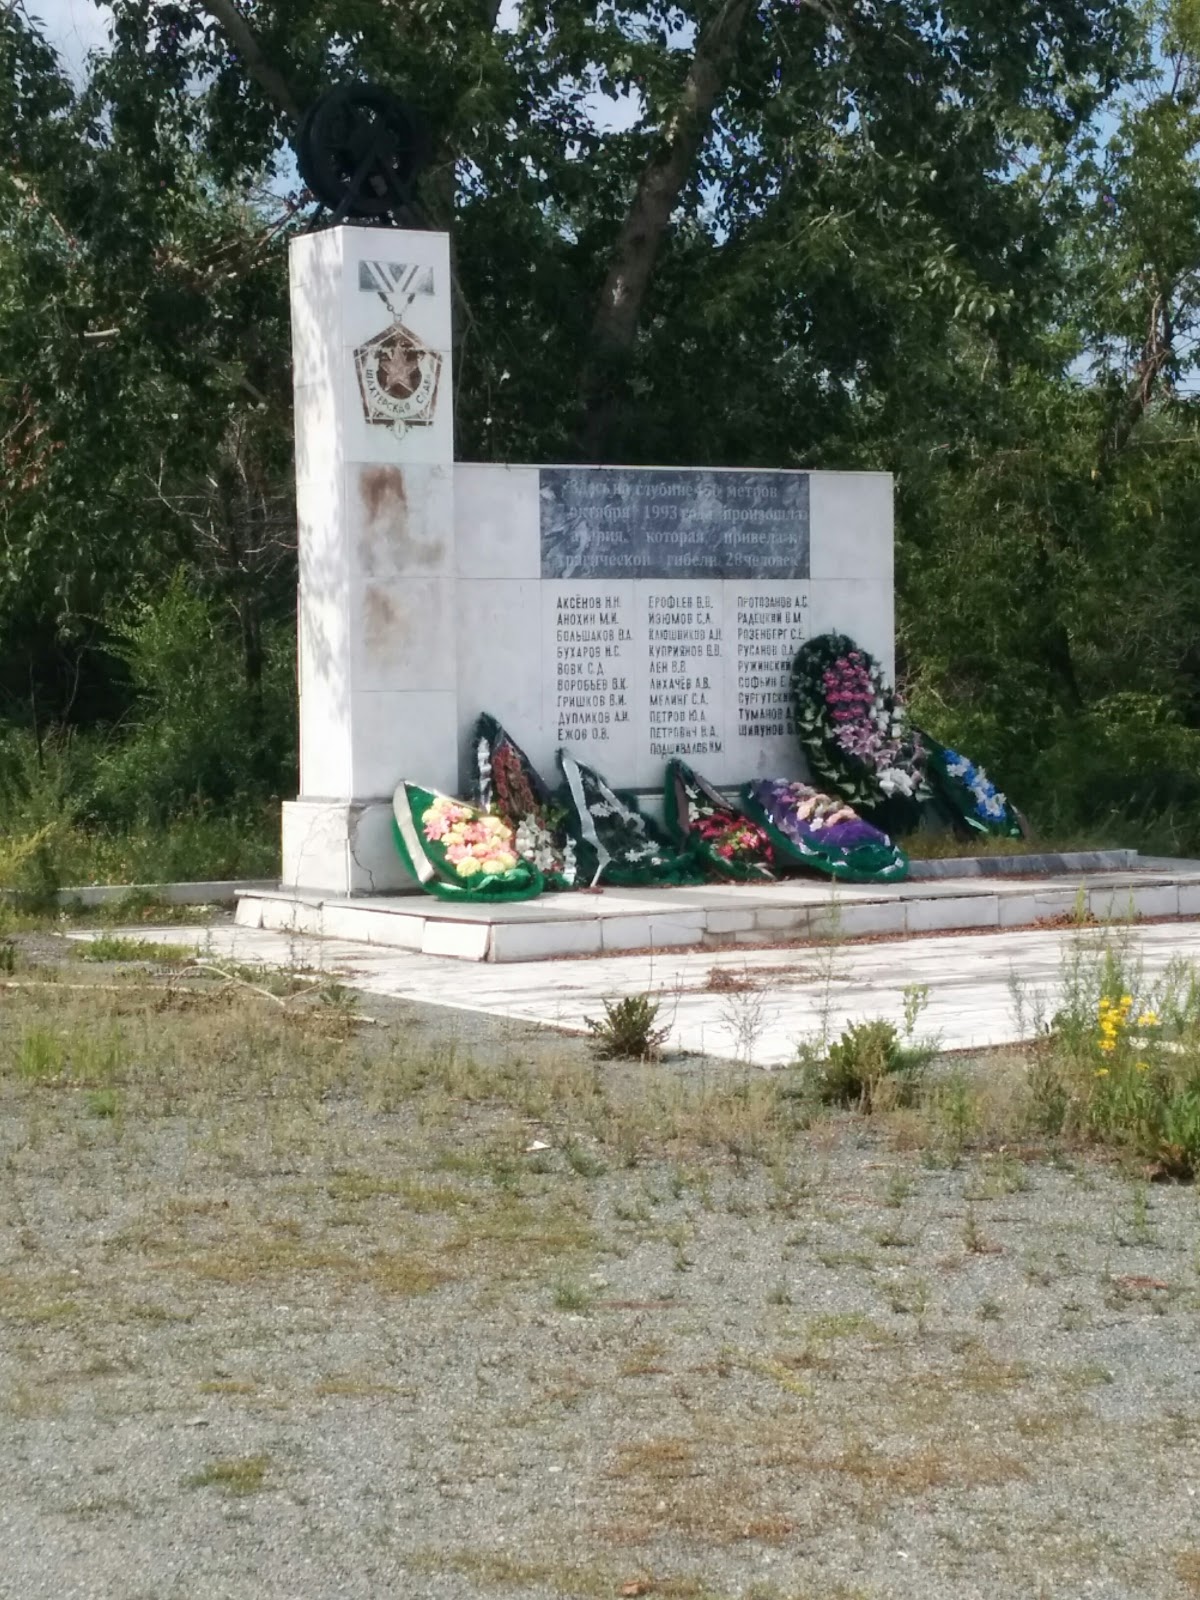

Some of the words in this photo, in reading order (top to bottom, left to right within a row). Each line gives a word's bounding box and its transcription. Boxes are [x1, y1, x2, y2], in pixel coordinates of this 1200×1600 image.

[635, 480, 693, 500] глубине
[727, 484, 778, 499] метров
[644, 504, 679, 520] 1993
[723, 508, 808, 524] произошла
[646, 530, 704, 547] которая
[724, 531, 784, 548] привела
[666, 551, 717, 568] гибели
[725, 551, 742, 567] 28
[743, 554, 799, 568] человек
[556, 594, 601, 609] АКСЁНОВ
[648, 595, 692, 609] ЕРОФЕЕВ
[557, 613, 595, 626] АНОХИН
[648, 613, 693, 625] ИЗЮМОВ
[737, 611, 782, 625] РАДЕЦКИЙ
[556, 629, 615, 642] БОЛЬШАКОВ
[737, 628, 788, 641] РОЗЕНБЕРГ
[556, 646, 601, 660] БУХАРОВ
[648, 645, 703, 659] КУПРИЯНОВ
[737, 644, 777, 657] РУСАНОВ
[557, 662, 583, 675] ВОВК
[649, 661, 668, 673] ЛЕН
[738, 658, 791, 673] РУЖИНСКИЙ
[650, 676, 691, 690] ЛИХАЧЁВ
[557, 695, 605, 707] ГРИШКОВ
[649, 710, 685, 723] ПЕТРОВ
[738, 708, 783, 721] ТУМАНОВ
[557, 728, 587, 741] ЕЖОВ
[650, 726, 697, 739] ПЕТРОВИЧ
